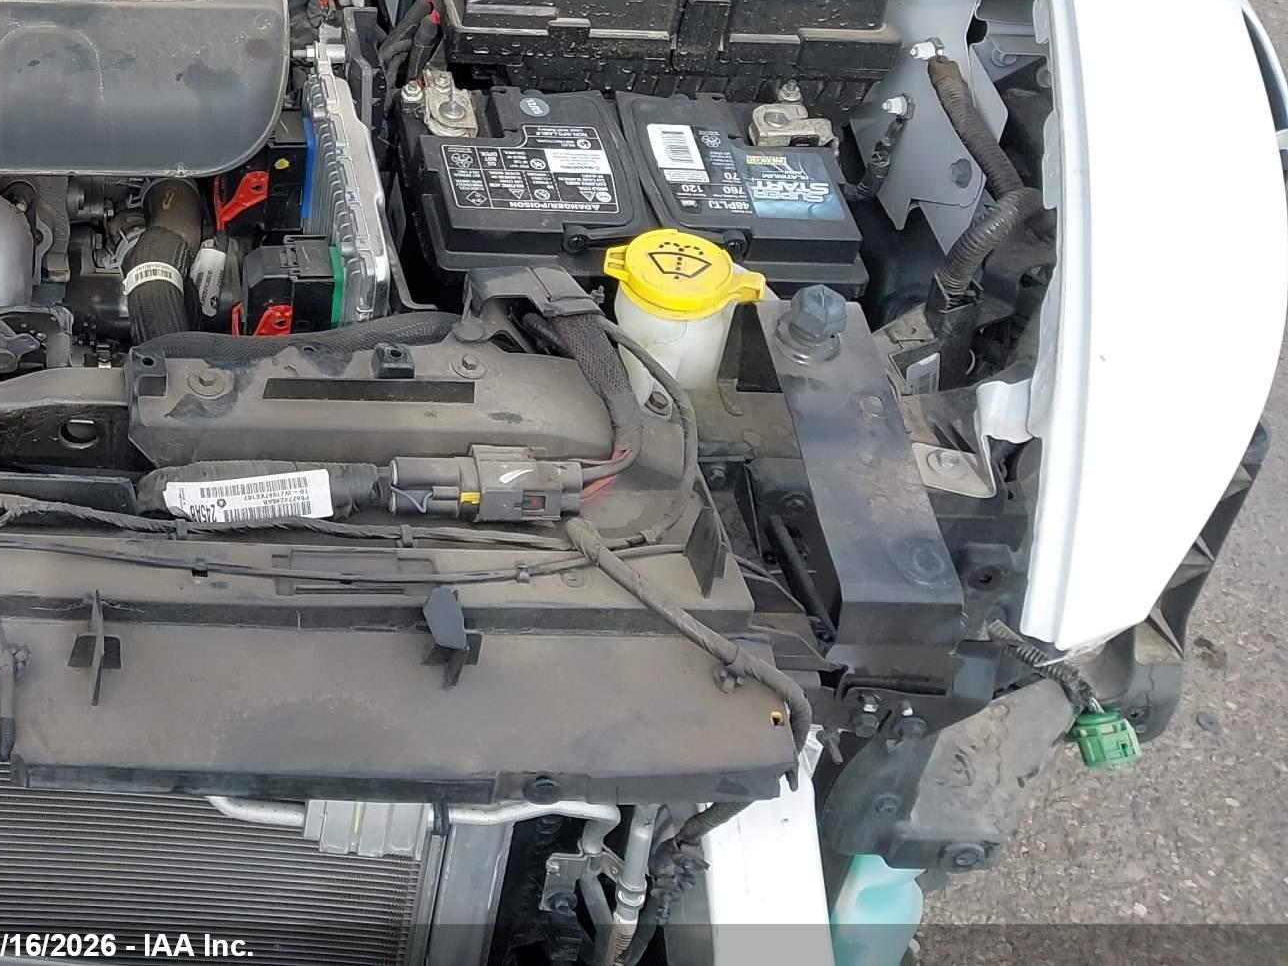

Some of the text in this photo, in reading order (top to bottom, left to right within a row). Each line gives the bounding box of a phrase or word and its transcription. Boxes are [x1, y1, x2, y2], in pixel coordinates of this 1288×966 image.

[724, 171, 740, 181] 70
[762, 172, 809, 180] PLATINUM
[681, 184, 745, 194] 760 120
[750, 180, 829, 194] START
[753, 189, 825, 202] SUPER
[509, 201, 595, 211] DANGER/POISON
[709, 200, 750, 210] 48PLTJ
[189, 504, 217, 523] 245AB
